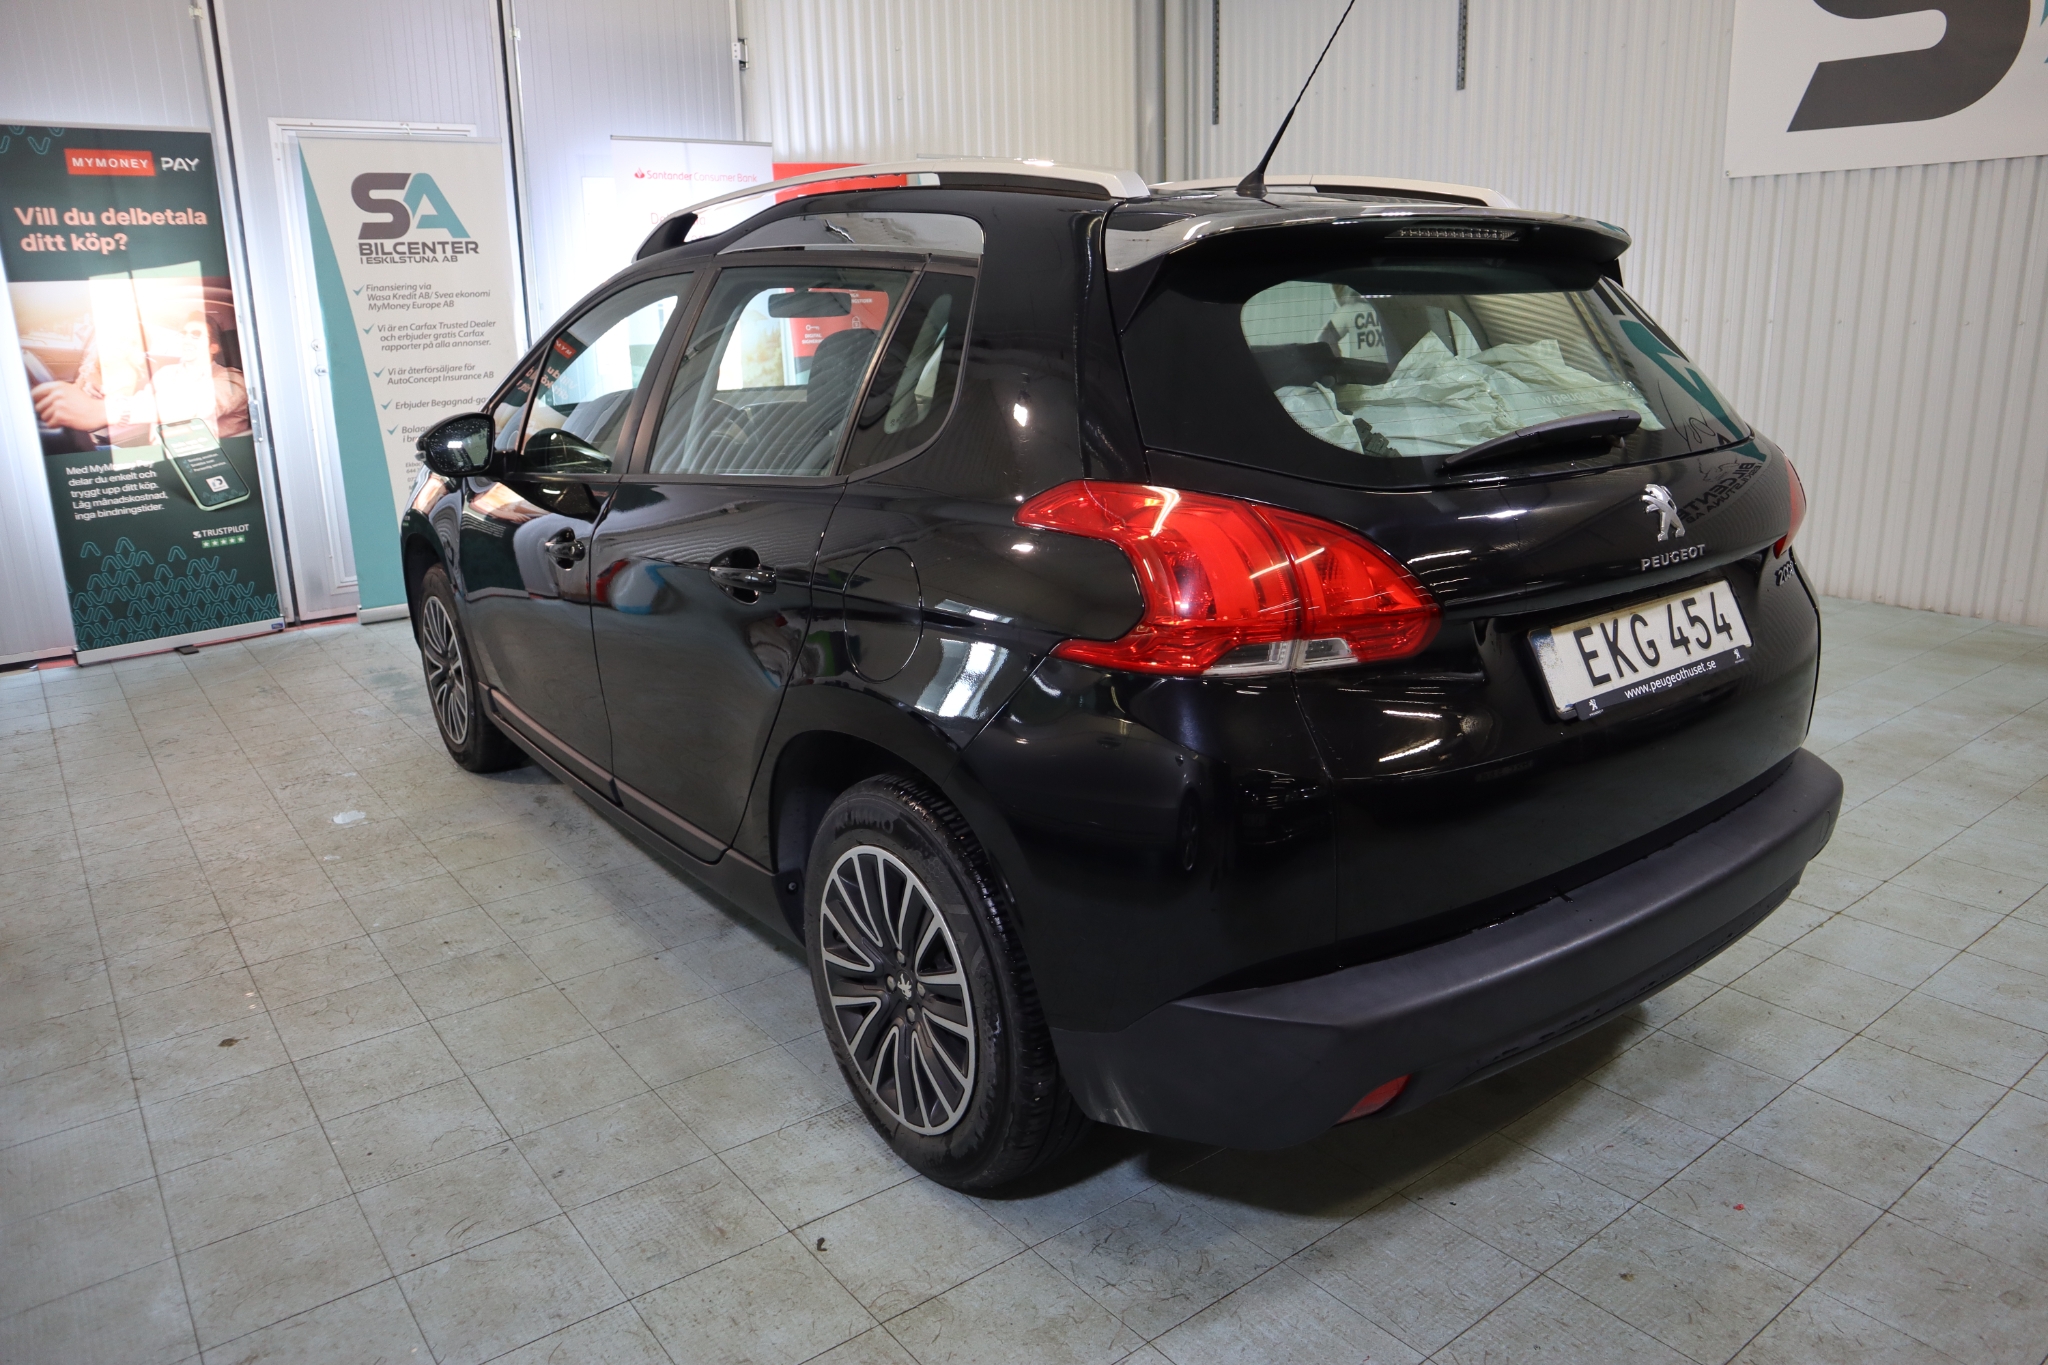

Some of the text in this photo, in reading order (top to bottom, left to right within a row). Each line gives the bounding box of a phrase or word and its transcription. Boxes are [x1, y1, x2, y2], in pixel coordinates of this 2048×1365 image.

[1786, 0, 2048, 133] S
[71, 157, 200, 172] MYMONEY PAY
[646, 170, 757, 183] Santander Consumer Bank
[351, 172, 471, 240] SA
[14, 207, 208, 226] Vill du delbetala
[20, 233, 128, 255] ditt köp?
[358, 241, 480, 256] BILCENTER
[366, 255, 440, 265] ESKILSTUNA
[442, 255, 458, 263] AB
[366, 282, 432, 293] Finansiering via
[367, 289, 491, 301] Wasa Kredit AB/ Svea ekonomi
[368, 300, 455, 312] MyMoney Europe AB
[377, 324, 386, 332] Vi
[387, 323, 397, 332] är
[409, 322, 437, 331] Carfax
[438, 321, 469, 330] Trusted
[469, 320, 497, 328] Dealer
[380, 329, 485, 342] och erbjuder gratis Carfax
[1357, 329, 1384, 350] FOX
[381, 338, 492, 353] rapporter på alla annonser.
[388, 363, 476, 376] Vi är återförsäljare för
[387, 371, 494, 386] AutoConcept Insurance AB
[395, 396, 487, 411] Erbjuder Begagnad-ga
[65, 465, 89, 475] Med
[68, 470, 157, 487] delar du enkelt och
[70, 481, 160, 499] tryggt upp ditt köp.
[72, 500, 92, 510] Låg
[74, 503, 165, 522] inga bindningstider.
[201, 523, 250, 538] TRUSTPILOT
[1640, 544, 1706, 572] PEUGEOT
[1573, 591, 1733, 687] EKG 454
[1624, 659, 1717, 700] www.peugeothuset.se
